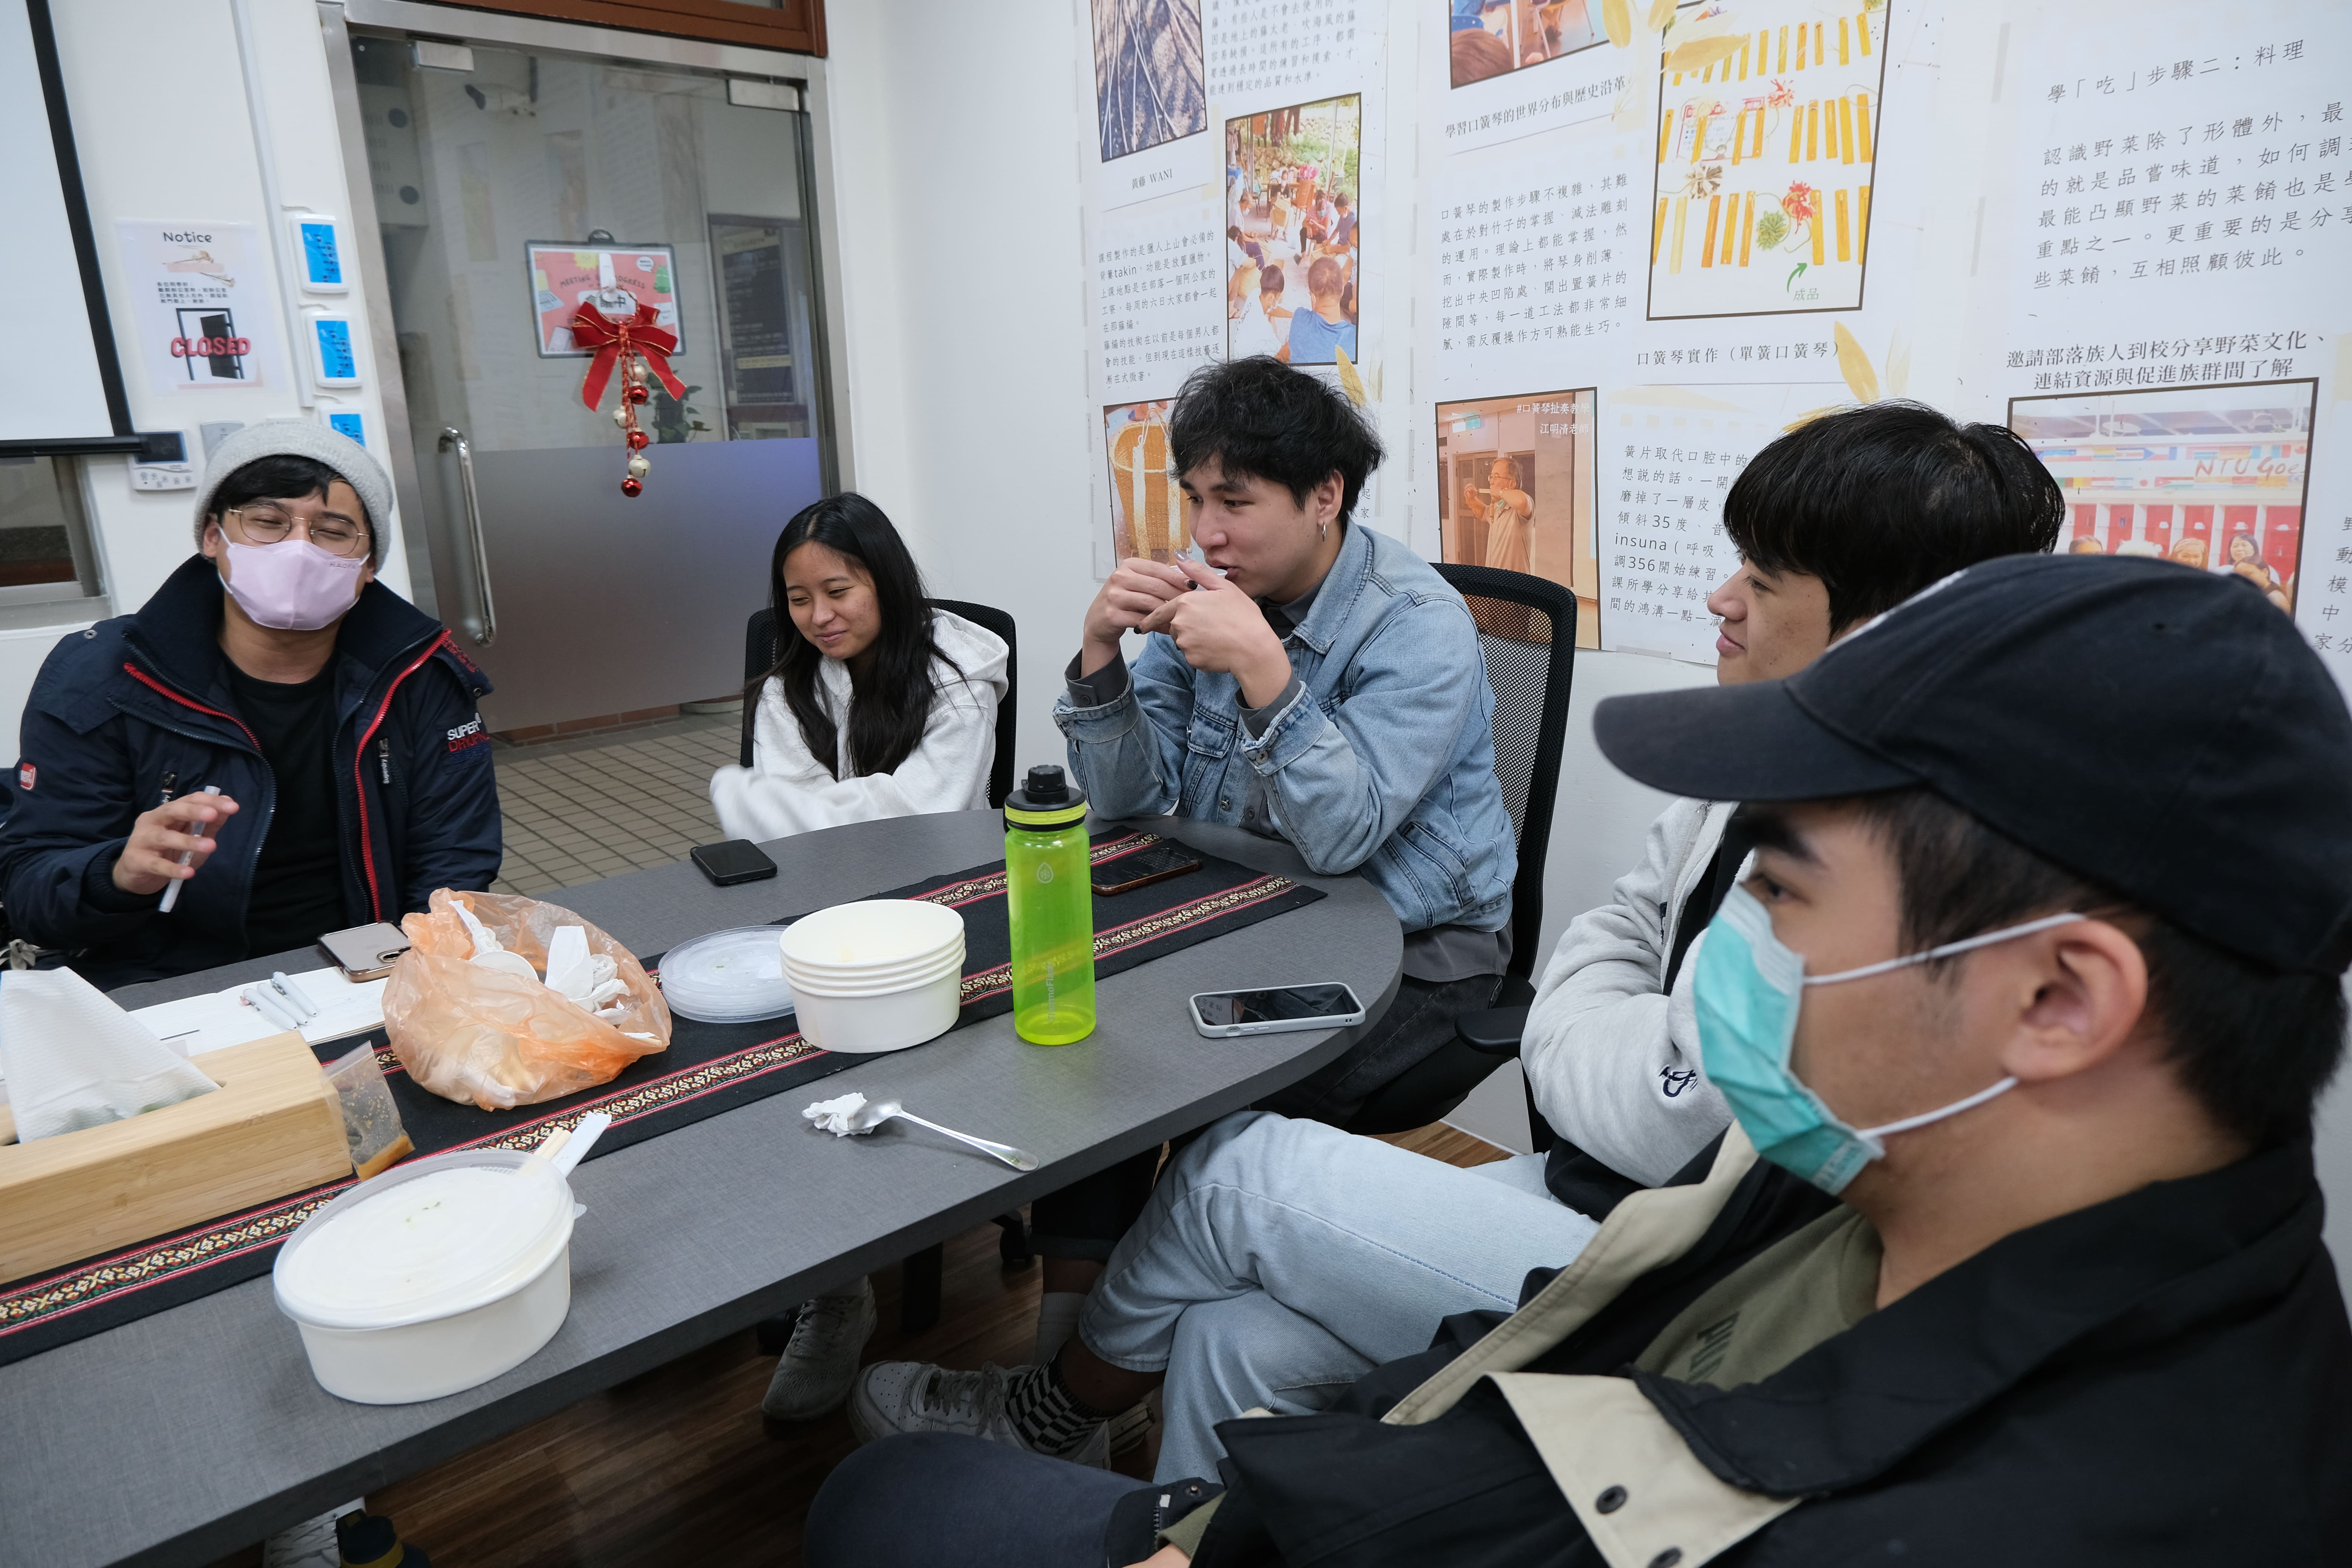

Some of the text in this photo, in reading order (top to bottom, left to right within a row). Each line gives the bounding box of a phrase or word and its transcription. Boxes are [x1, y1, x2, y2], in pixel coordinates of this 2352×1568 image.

[2047, 39, 2304, 103] 學「吃」步驟二：料理
[2044, 102, 2344, 166] 認識野菜除了形體外，最
[1149, 168, 1172, 183] WANI
[2041, 137, 2352, 197] 的就是品嘗味道，如何調
[163, 231, 212, 243] Notice
[1442, 222, 1627, 265] 的運用。理論上都能掌握，然
[1793, 288, 1819, 301] 成品
[171, 336, 251, 358] CLOSED
[2006, 331, 2325, 369] 邀請部落族人到校分享野菜文化、
[2034, 358, 2294, 390] 連結資源與促進族群間了解
[1540, 423, 1589, 435] 江明清老師
[2327, 575, 2348, 594] 模
[2322, 605, 2340, 621] 中
[447, 721, 480, 741] SUPER
